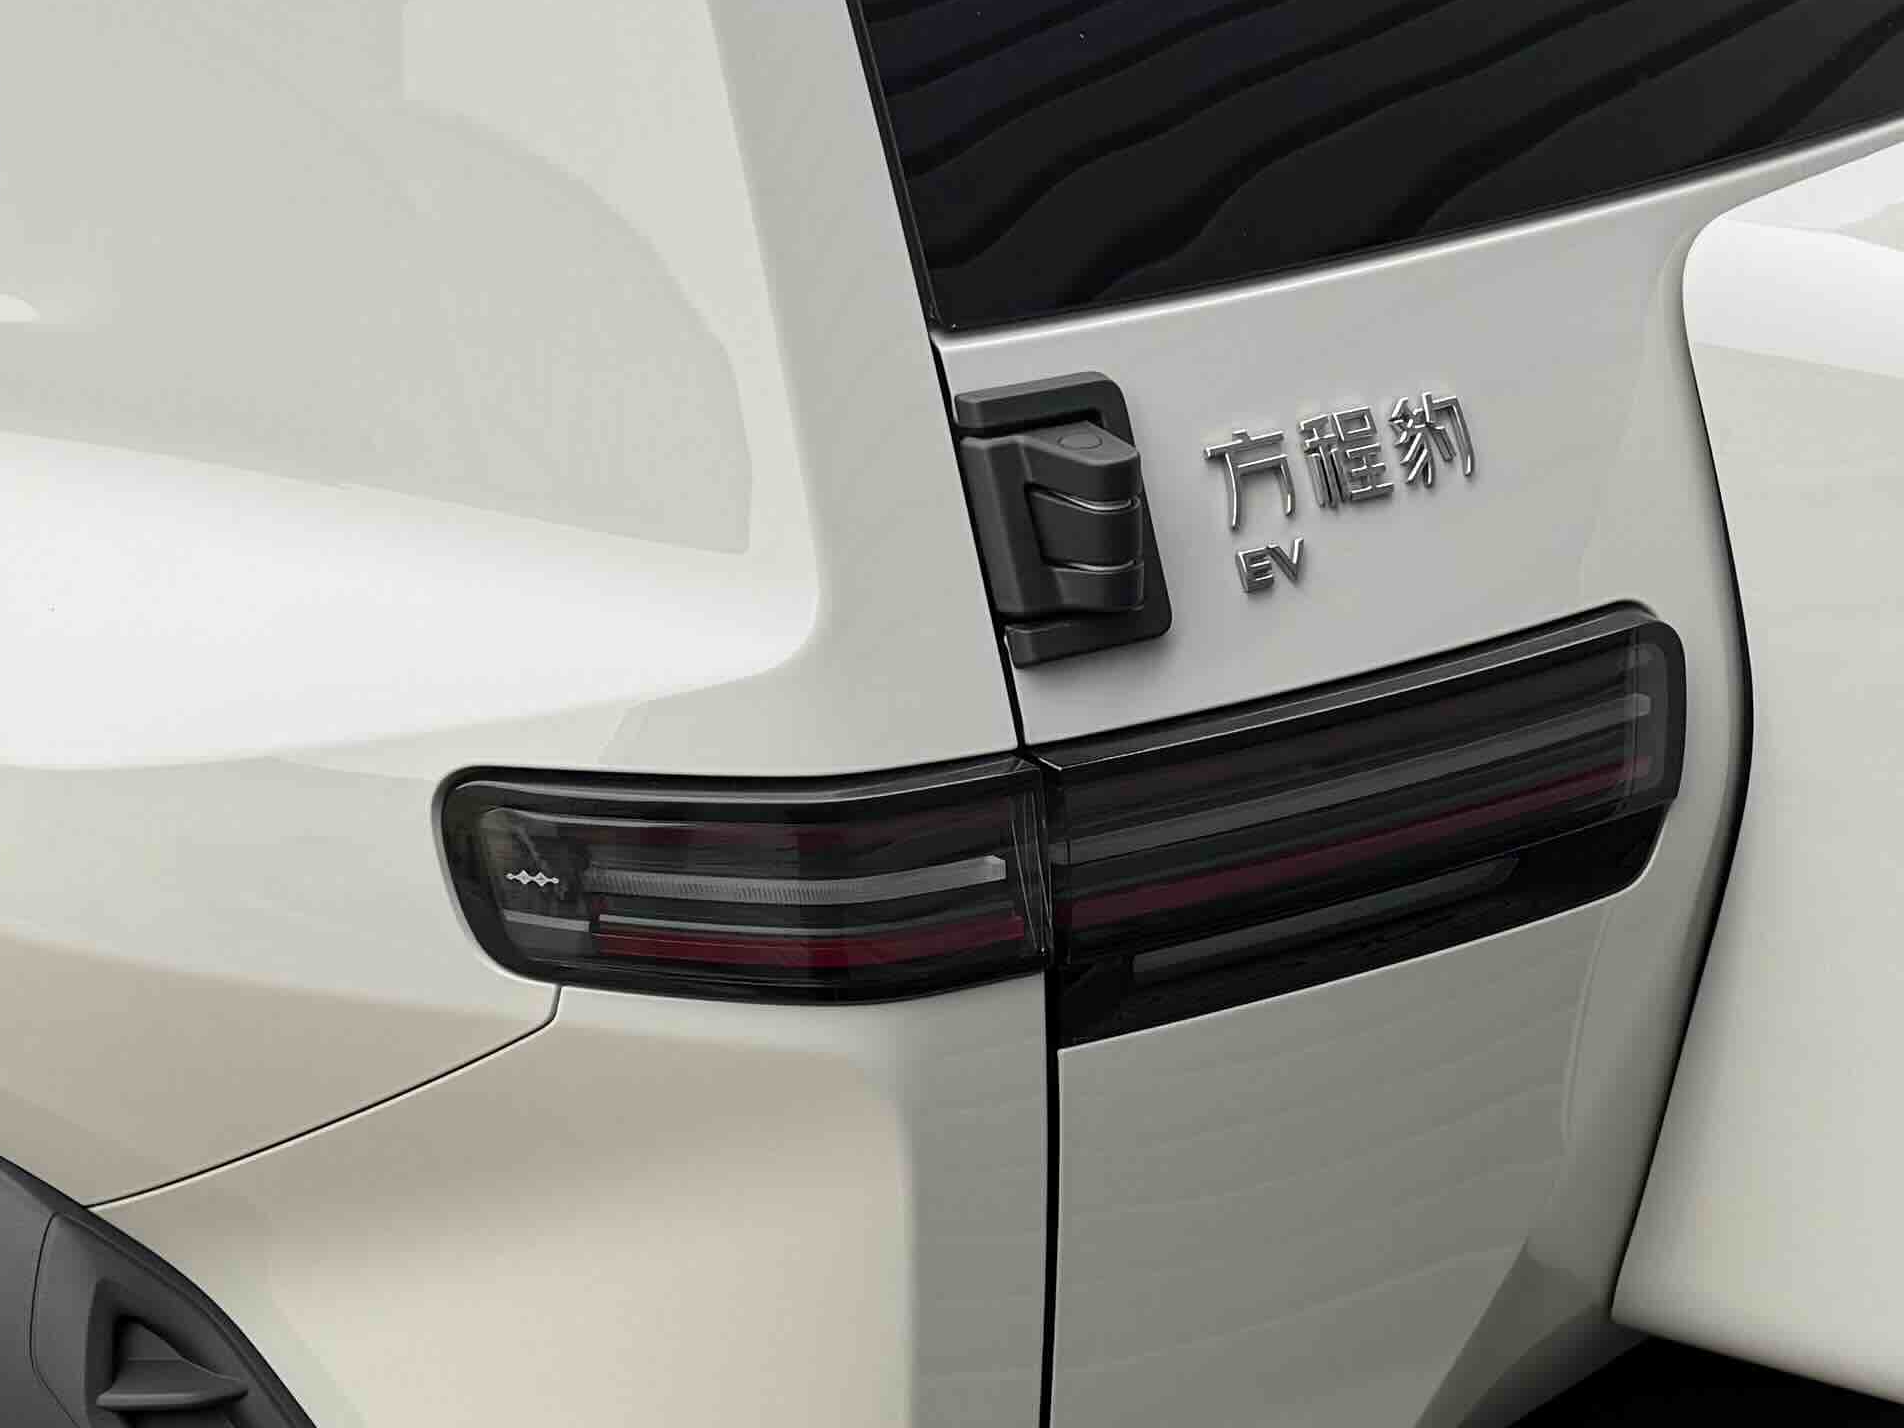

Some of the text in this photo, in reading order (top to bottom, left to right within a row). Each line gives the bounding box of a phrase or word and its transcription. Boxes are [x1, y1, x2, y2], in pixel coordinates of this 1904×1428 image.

[1203, 391, 1478, 530] 方程豹
[1236, 537, 1306, 593] EV
